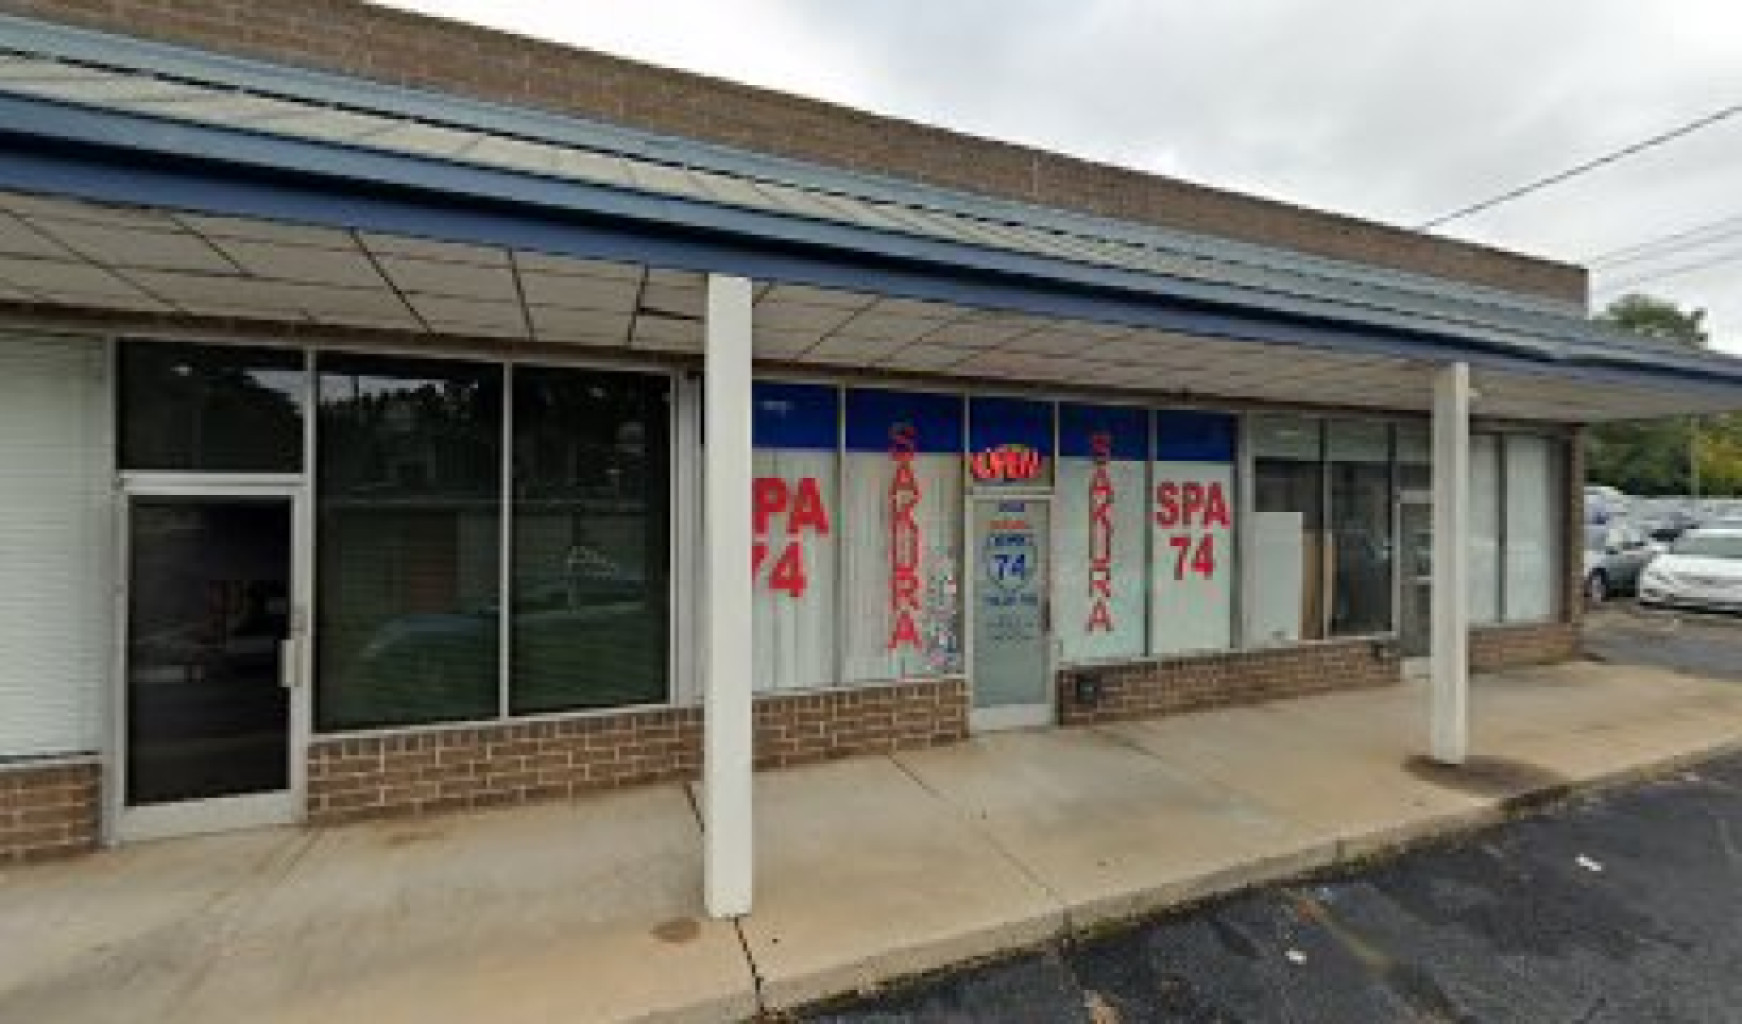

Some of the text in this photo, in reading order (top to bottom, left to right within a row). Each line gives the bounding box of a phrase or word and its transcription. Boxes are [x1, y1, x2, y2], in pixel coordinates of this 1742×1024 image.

[974, 447, 1039, 479] OPEN
[752, 476, 829, 535] PA
[1156, 481, 1231, 529] SPA
[888, 423, 922, 651] SAKURA
[1087, 434, 1114, 632] SAKURA
[1169, 534, 1216, 580] 74
[994, 554, 1025, 580] 74
